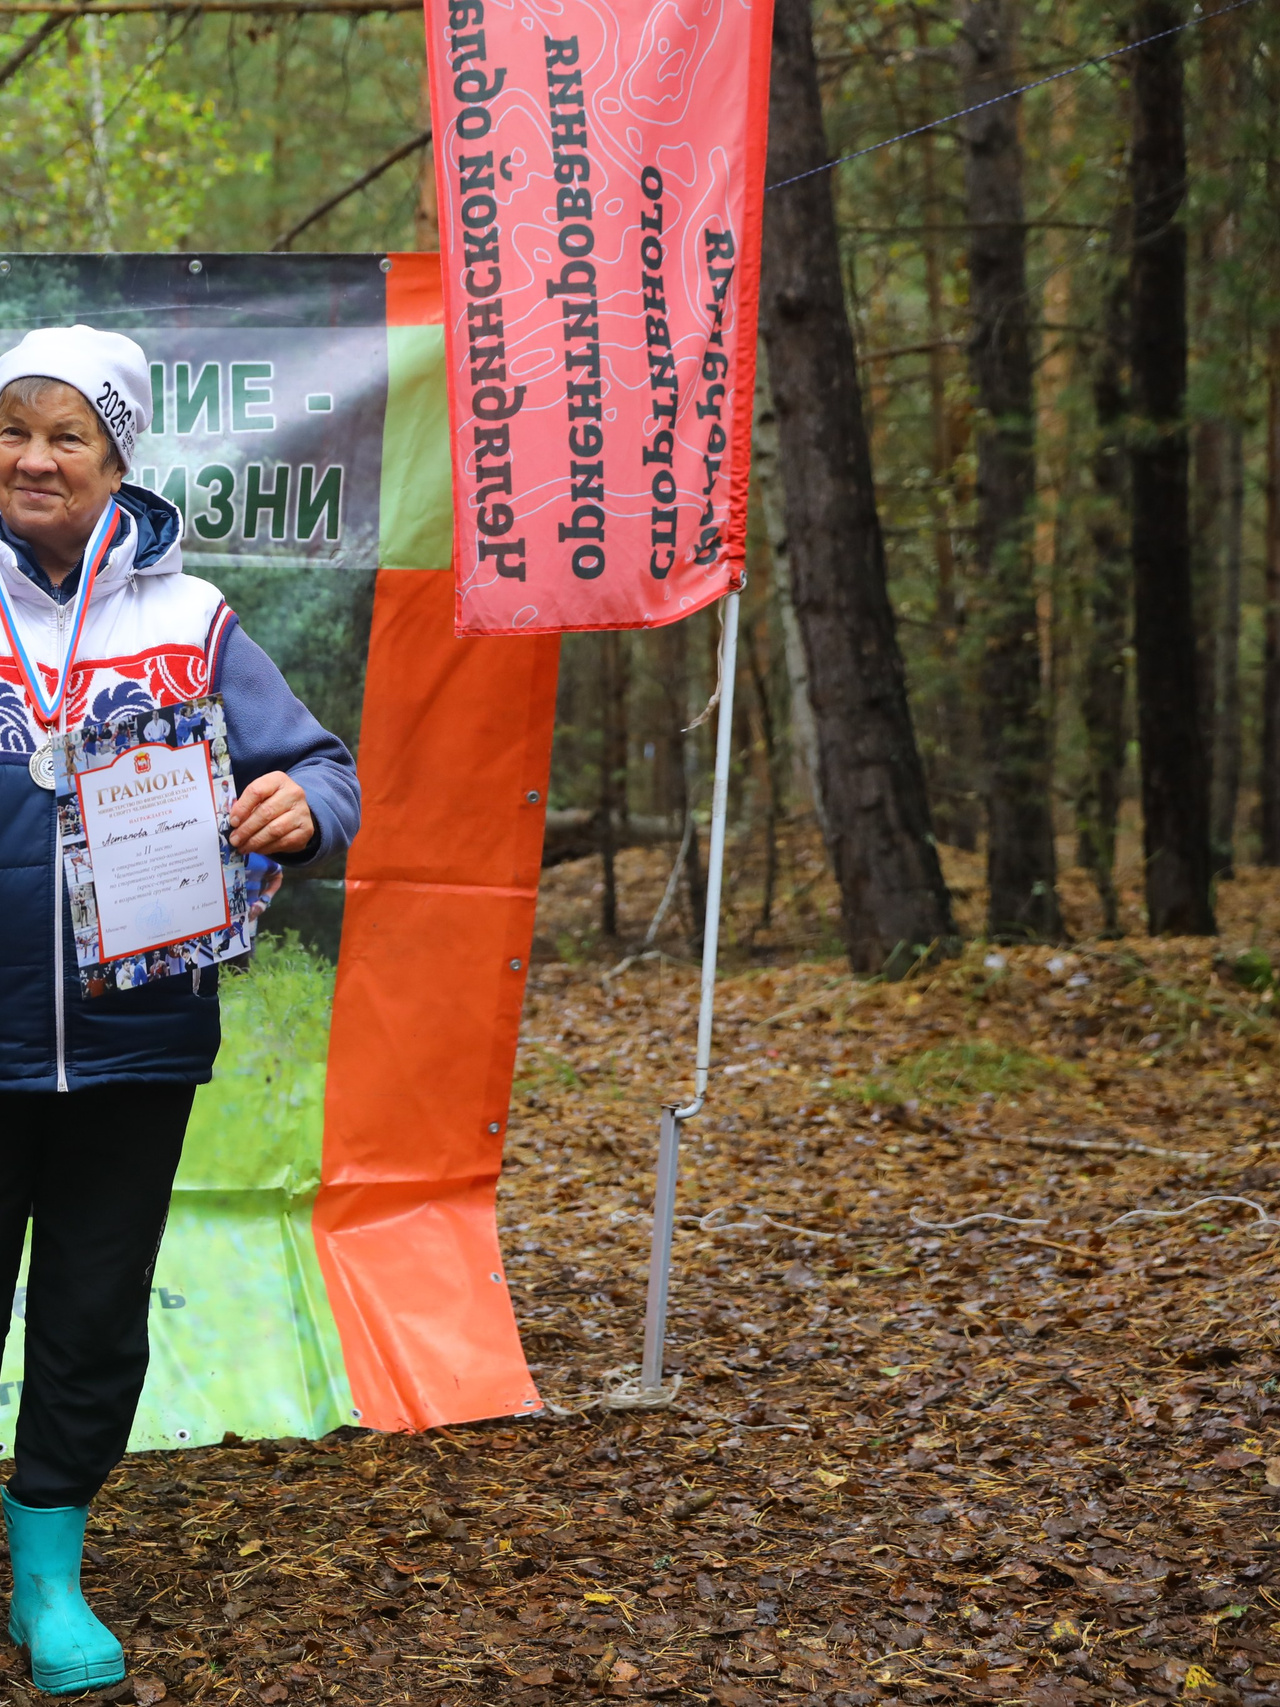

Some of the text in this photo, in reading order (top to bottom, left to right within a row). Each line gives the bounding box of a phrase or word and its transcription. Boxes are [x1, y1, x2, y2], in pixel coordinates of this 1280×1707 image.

[96, 381, 132, 438] 2026
[122, 463, 345, 543] ИЗНИ
[96, 767, 195, 806] ГРАМОТА
[128, 808, 172, 824] НАГРАЖДАЕТСЯ
